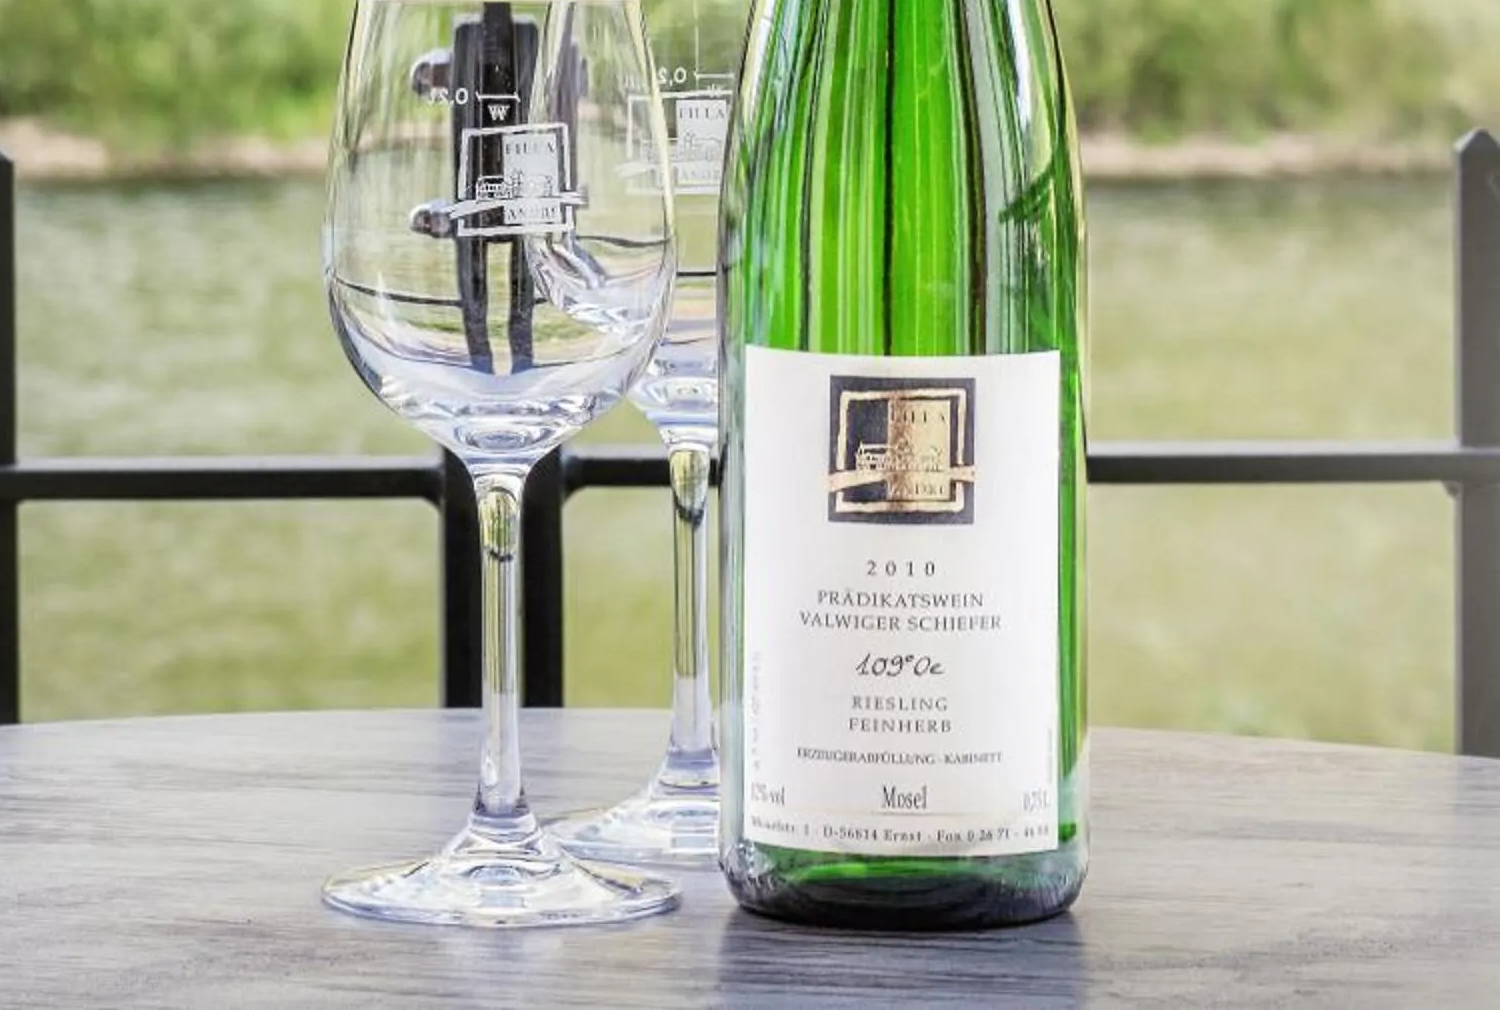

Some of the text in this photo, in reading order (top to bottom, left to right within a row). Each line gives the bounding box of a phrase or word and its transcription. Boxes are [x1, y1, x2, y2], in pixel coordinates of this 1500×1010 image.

[866, 559, 936, 577] 2010
[817, 587, 985, 608] PRÄDIKATSWEIN
[800, 610, 1002, 631] VALWIGER SCHIEFER
[851, 695, 949, 712] RIESLING
[849, 717, 952, 734] FEINHERB
[797, 746, 937, 765] ERZEUGERABFÜLLUNG
[881, 783, 928, 810] Mosel
[883, 827, 922, 842] Ernst
